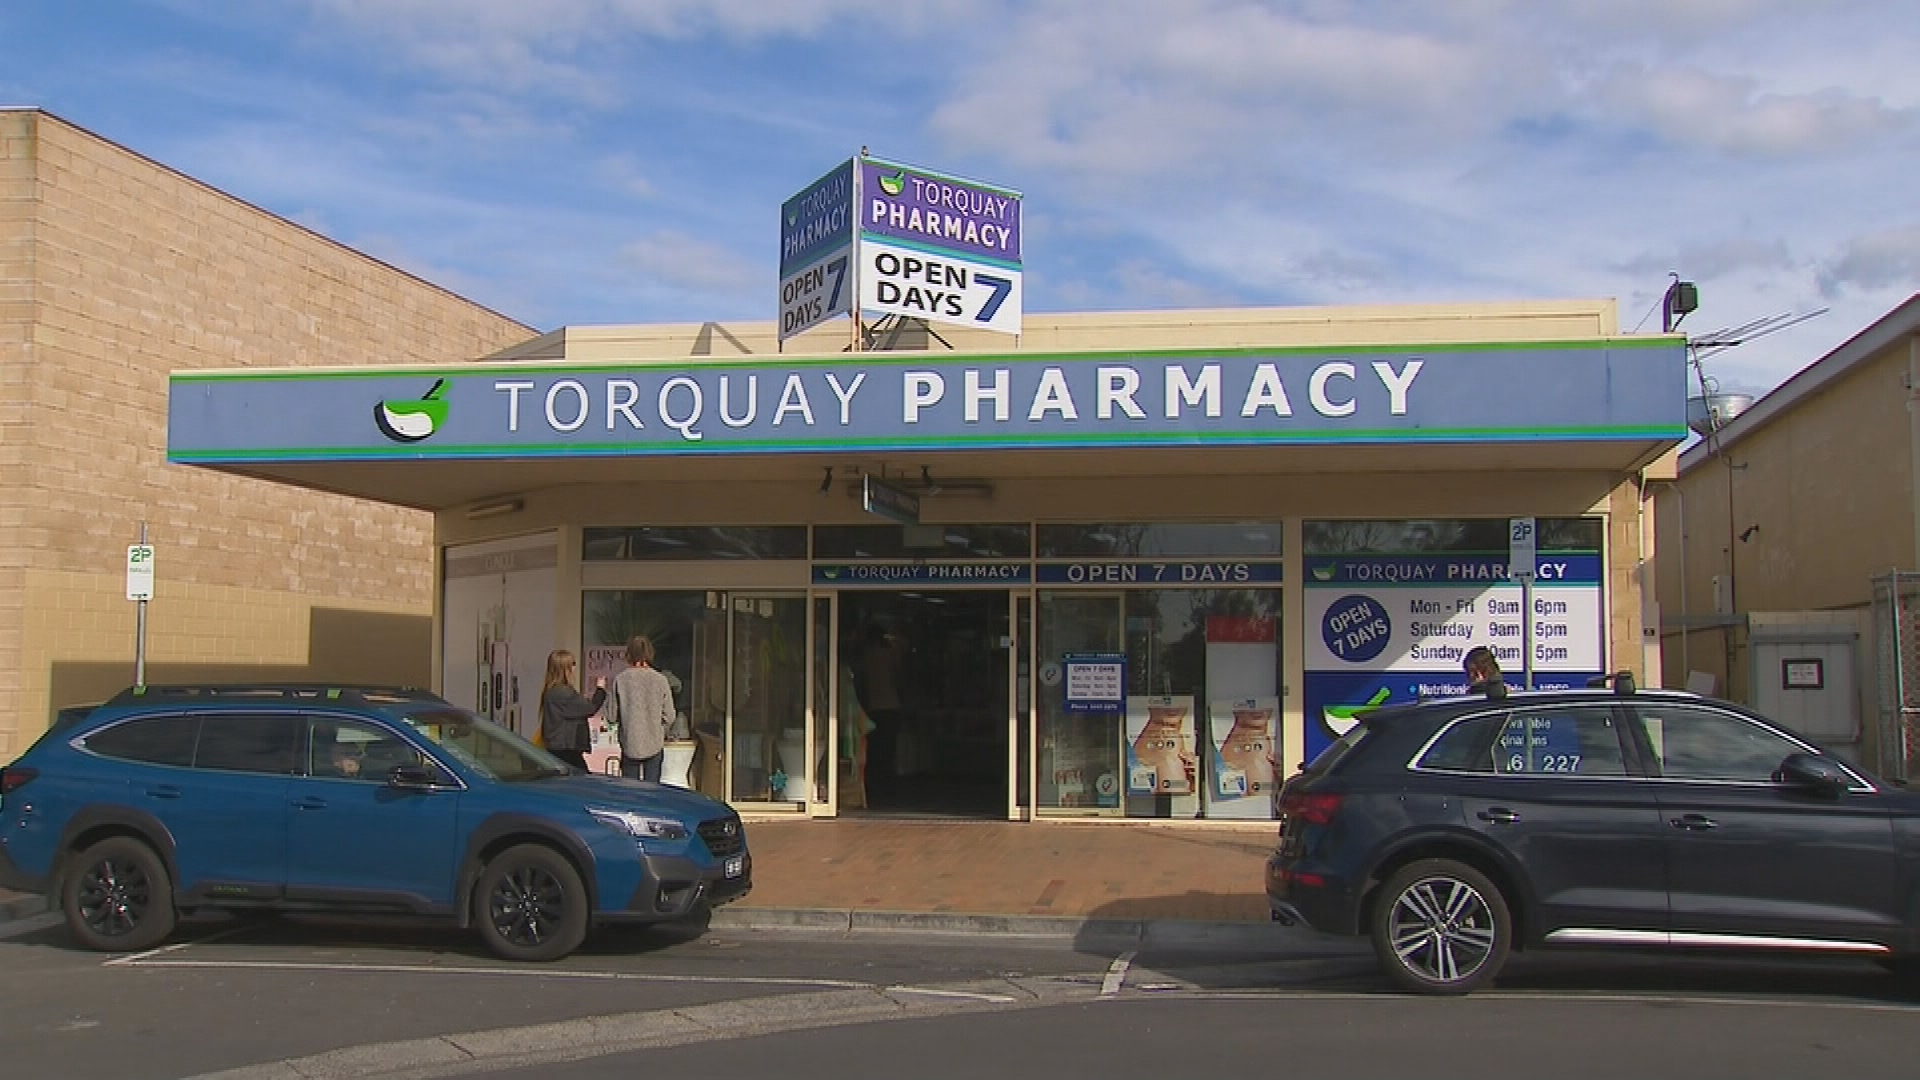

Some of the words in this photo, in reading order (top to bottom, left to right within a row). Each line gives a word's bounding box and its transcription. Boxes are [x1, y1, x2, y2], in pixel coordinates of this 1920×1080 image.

[801, 174, 848, 217] TORQUAY
[912, 178, 1008, 219] TORQUAY
[784, 204, 848, 260] PHARMACY
[871, 199, 1011, 250] PHARMACY
[783, 263, 824, 304] OPEN
[827, 256, 848, 312] 7
[874, 252, 967, 289] OPEN
[973, 273, 1013, 322] 7
[876, 281, 963, 317] DAYS
[784, 296, 822, 332] DAYS
[494, 373, 867, 440] TORQUAY
[903, 361, 1424, 423] PHARMACY
[1512, 525, 1532, 540] 2P
[131, 548, 152, 562] 2P
[850, 566, 919, 580] TORQUAY
[929, 565, 1021, 578] PHARMACY
[1067, 564, 1137, 582] OPEN
[1153, 565, 1166, 580] 7
[1182, 564, 1250, 581] DAYS
[1345, 564, 1436, 580] TORQUAY
[1448, 563, 1567, 579] PHARCY
[1330, 602, 1373, 634] OPEN
[1410, 600, 1441, 614] Mon
[1456, 600, 1475, 614] Fri
[1488, 600, 1520, 614] 9am
[1535, 600, 1567, 617] 6pm
[1333, 640, 1346, 656] 7
[1348, 618, 1388, 651] DAYS
[1411, 622, 1473, 640] Saturday
[1489, 622, 1520, 637] 9am
[1535, 622, 1567, 640] 5pm
[1411, 645, 1464, 662] Sunday
[1535, 645, 1568, 662] 5pm
